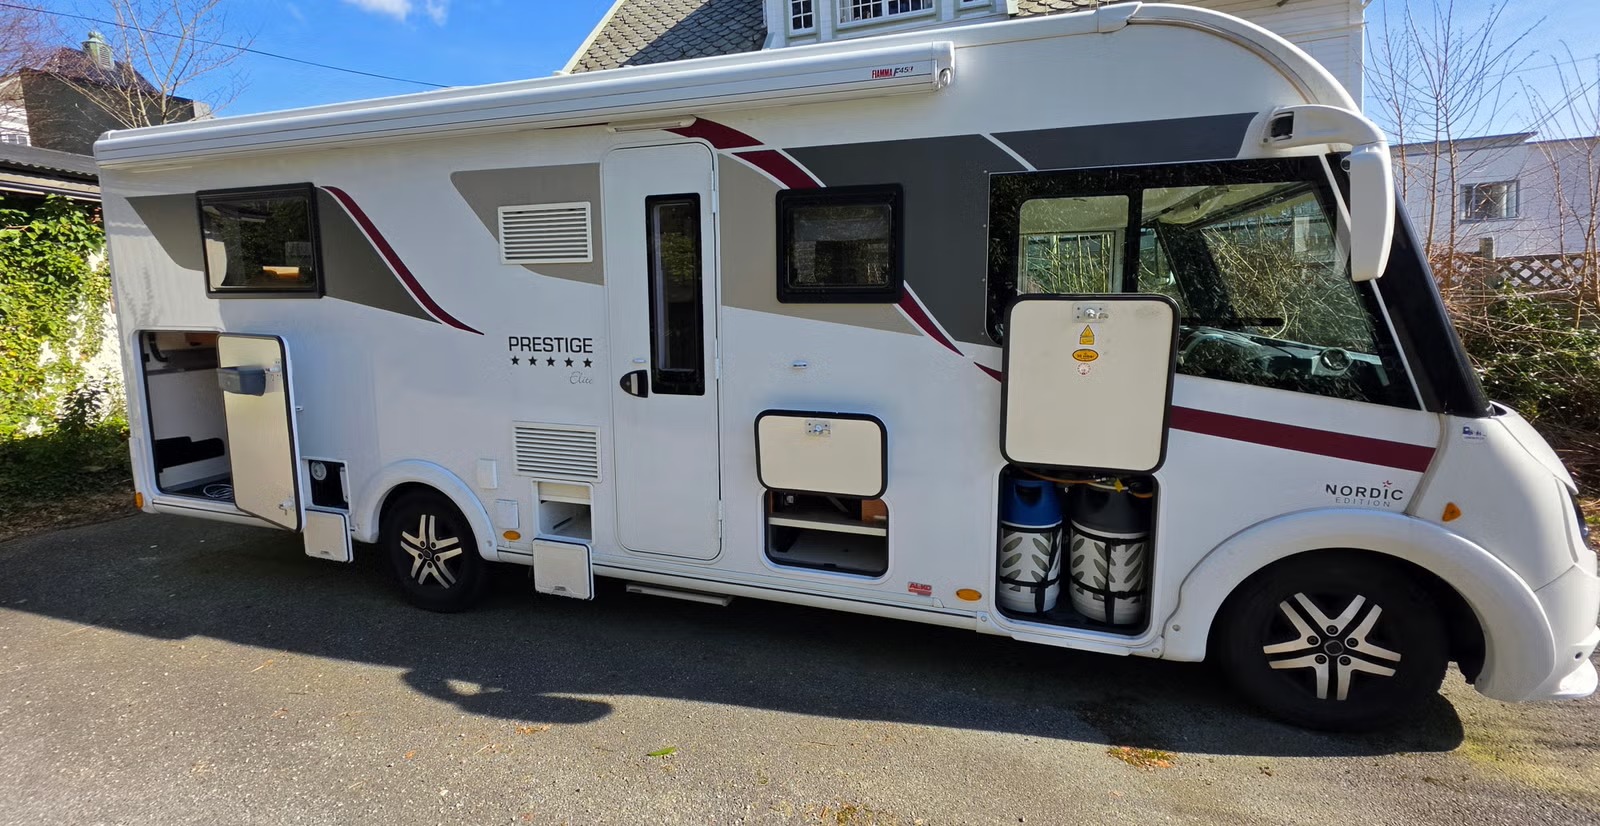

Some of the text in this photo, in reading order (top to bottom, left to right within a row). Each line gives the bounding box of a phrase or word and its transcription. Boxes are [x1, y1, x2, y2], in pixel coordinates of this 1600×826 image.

[871, 68, 893, 79] FIAMMA
[508, 336, 593, 354] PRESTIGE
[569, 371, 593, 385] Elite
[1325, 483, 1404, 501] NORDIC
[1335, 496, 1391, 508] EDITION
